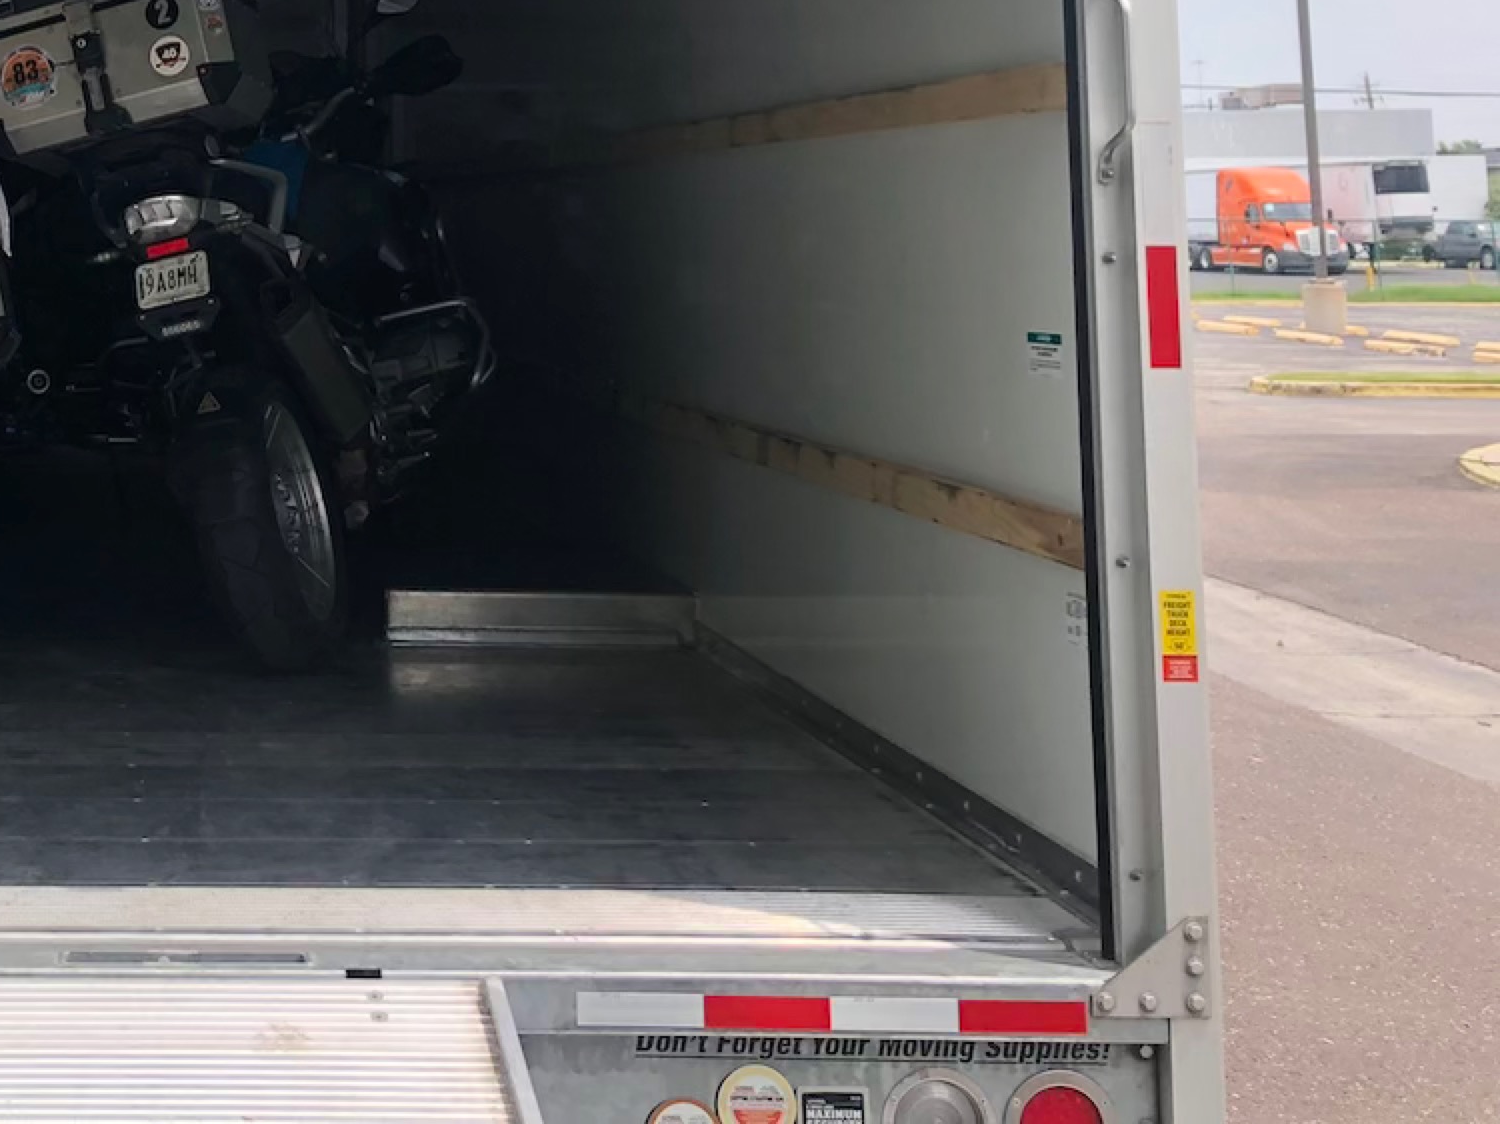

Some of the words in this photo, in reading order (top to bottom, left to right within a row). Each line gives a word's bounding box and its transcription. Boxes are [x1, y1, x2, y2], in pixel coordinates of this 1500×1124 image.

[13, 60, 39, 84] 83
[635, 1035, 709, 1053] Don't
[716, 1036, 805, 1059] Forget
[813, 1037, 871, 1055] Your
[877, 1039, 977, 1063] Moving
[985, 1041, 1110, 1064] Supplies!
